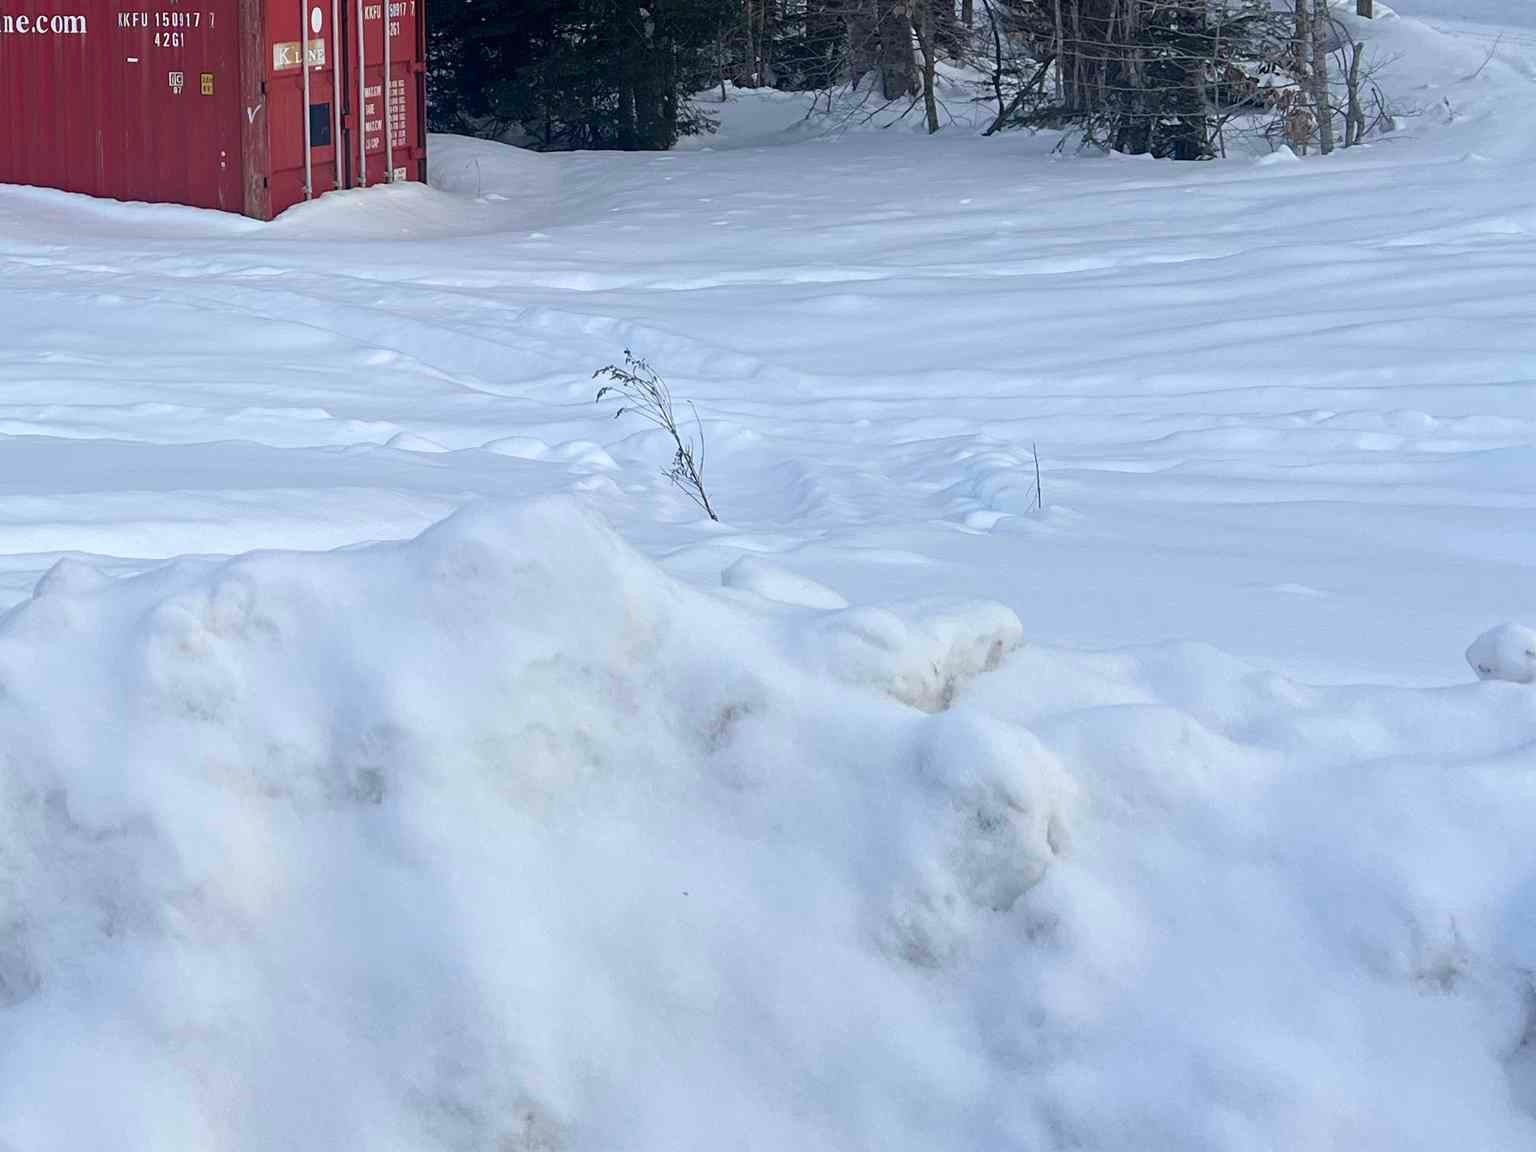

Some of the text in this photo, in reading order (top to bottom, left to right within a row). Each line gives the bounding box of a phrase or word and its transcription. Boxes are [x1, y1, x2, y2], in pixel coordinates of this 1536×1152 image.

[118, 12, 148, 27] KKFU
[155, 12, 200, 28] 150917
[295, 47, 324, 64] LNE
